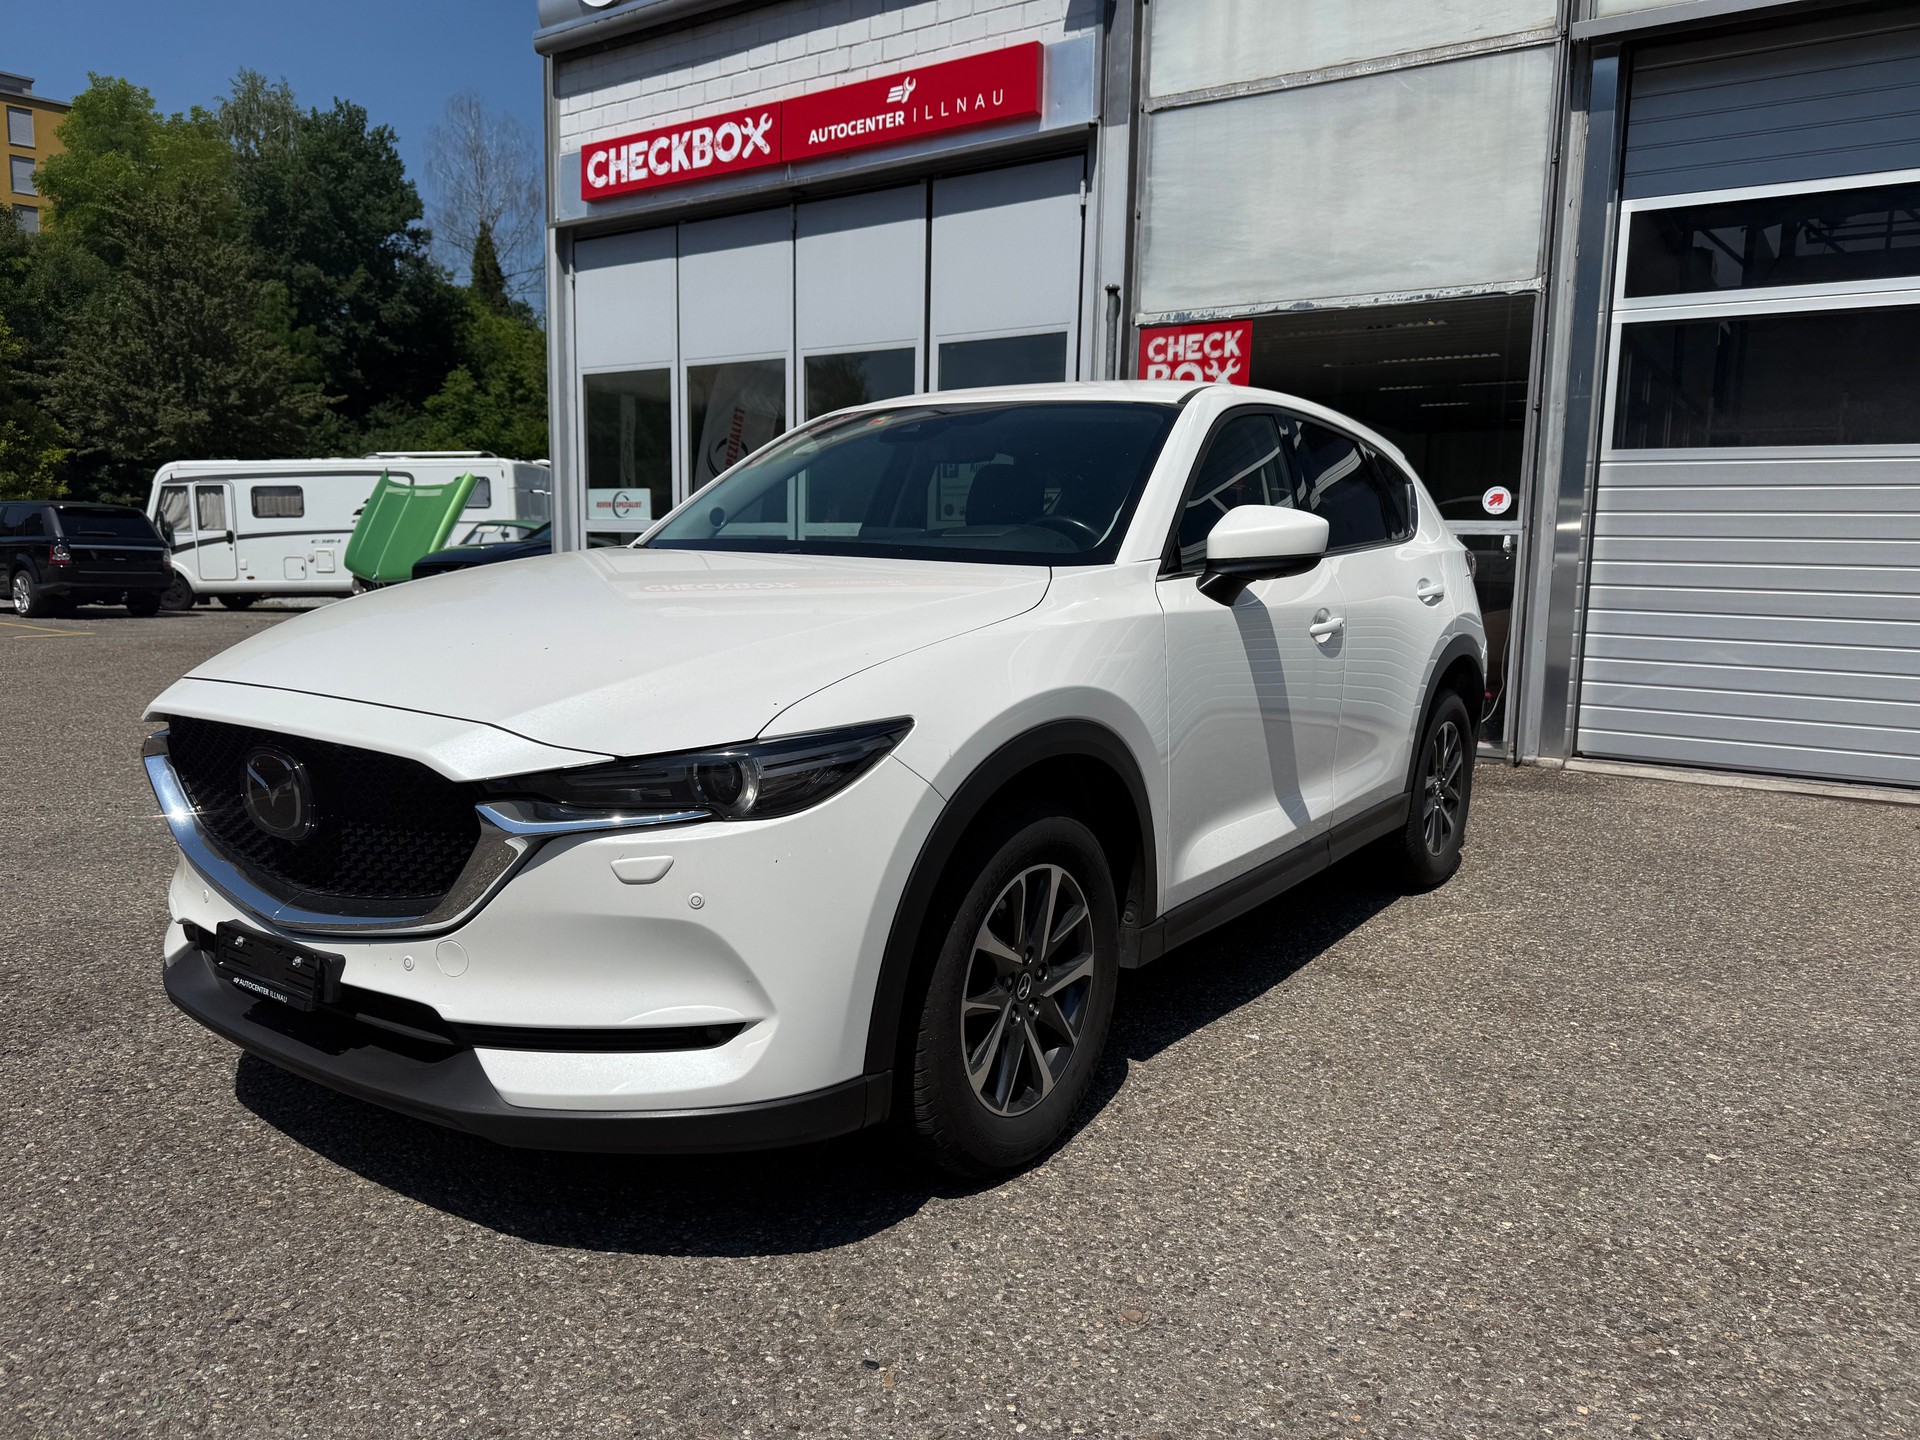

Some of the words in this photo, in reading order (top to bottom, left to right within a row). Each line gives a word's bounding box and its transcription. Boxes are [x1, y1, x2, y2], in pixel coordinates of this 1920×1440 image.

[808, 110, 905, 145] AUTOCENTER
[913, 88, 1004, 122] ILLNAU
[586, 112, 773, 188] CHECKBOX
[1147, 329, 1243, 362] CHECK
[724, 406, 746, 470] PEZIALIST
[239, 978, 269, 995] AUTOCENTER
[269, 990, 288, 1003] ILLNAU
